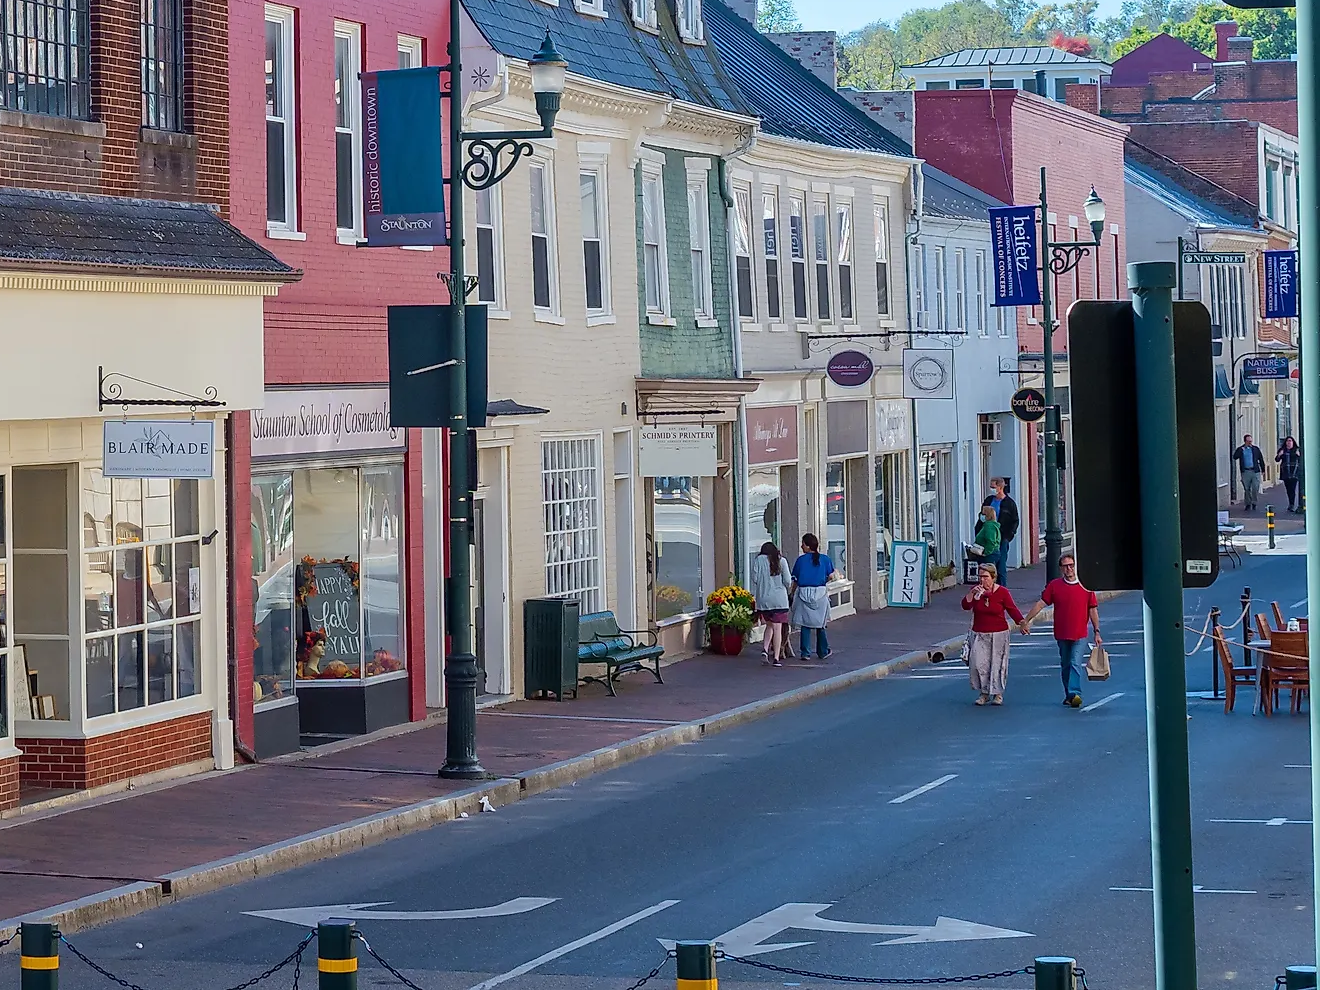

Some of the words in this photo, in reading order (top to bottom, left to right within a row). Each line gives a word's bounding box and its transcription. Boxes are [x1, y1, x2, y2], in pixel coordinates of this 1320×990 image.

[366, 87, 378, 159] downtown
[369, 163, 381, 212] historic
[380, 218, 433, 231] STAUNTON
[1013, 215, 1031, 271] heifetz
[998, 249, 1004, 258] OF
[1280, 256, 1292, 294] heifetz
[1247, 359, 1285, 367] NATURE'S
[1257, 367, 1277, 375] BLISS
[253, 410, 297, 439] Staunton
[298, 404, 331, 437] School
[332, 402, 345, 443] of
[679, 431, 715, 439] PRINTERY
[108, 442, 155, 454] BLAIR
[161, 443, 209, 454] MADE
[902, 548, 919, 602] OPEN
[312, 599, 359, 637] fall
